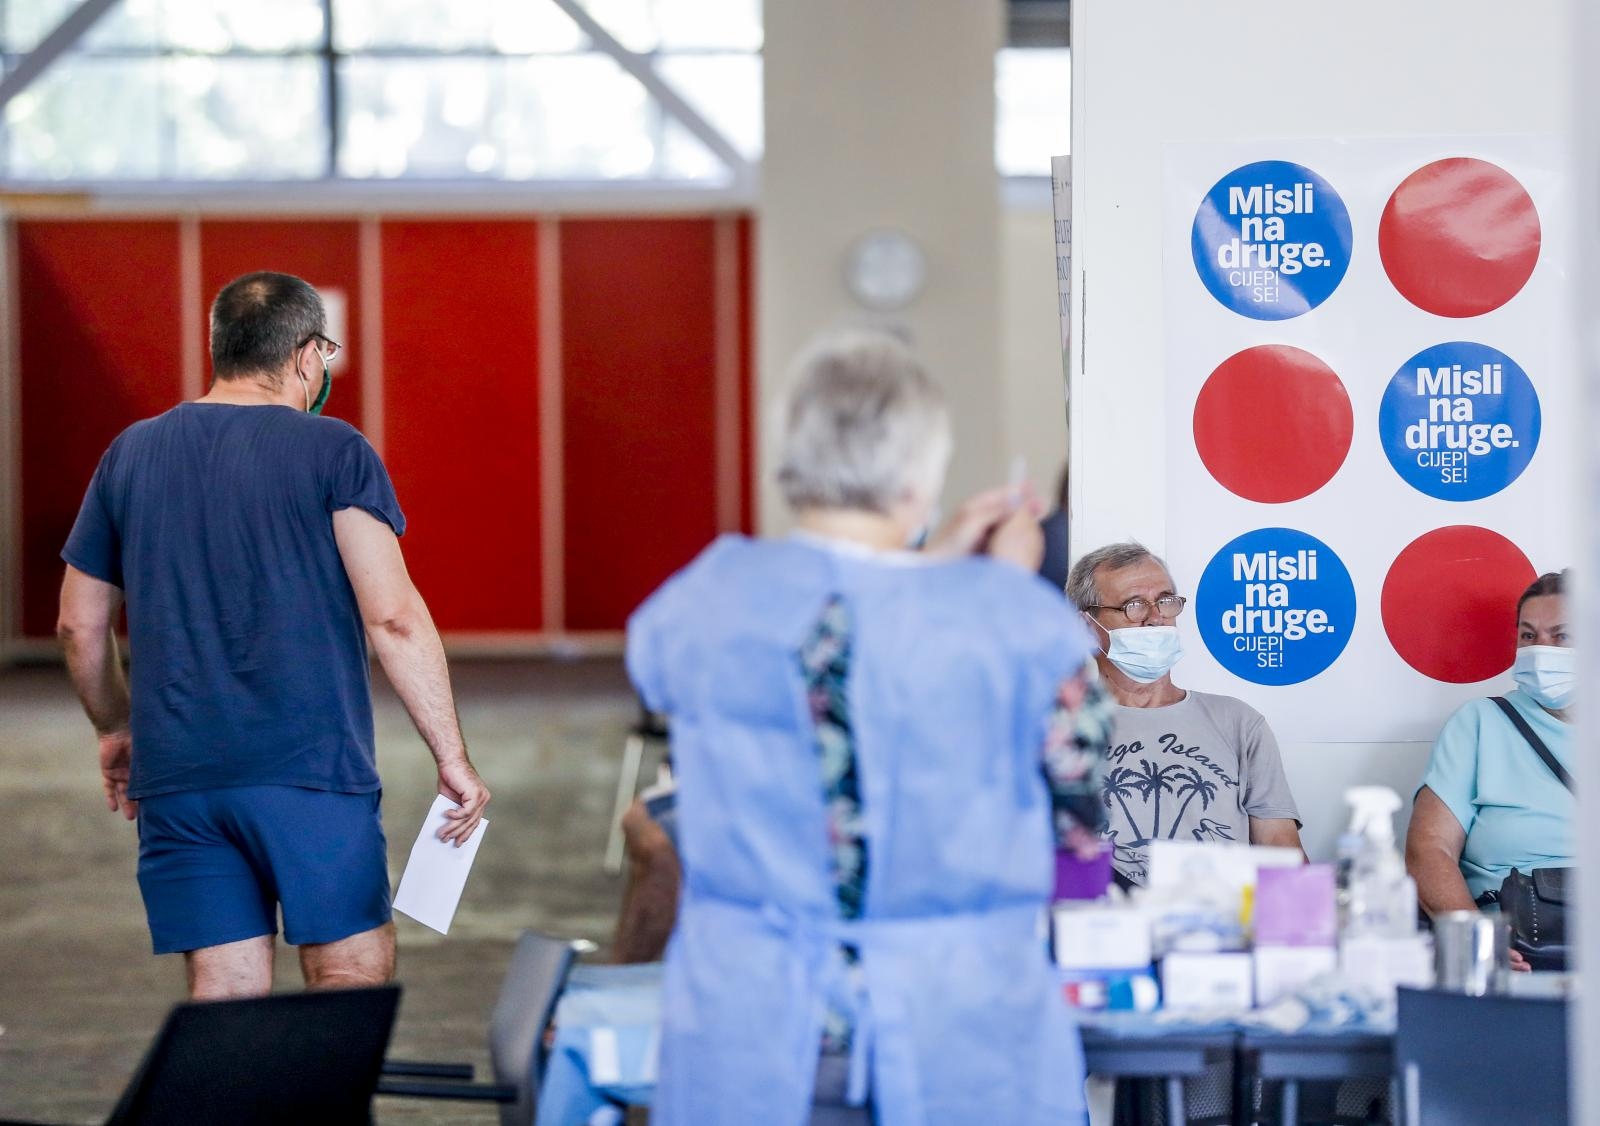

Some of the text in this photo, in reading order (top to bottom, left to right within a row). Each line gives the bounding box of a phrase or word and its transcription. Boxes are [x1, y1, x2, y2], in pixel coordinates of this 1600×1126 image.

[1229, 183, 1313, 214] Misli
[1241, 217, 1285, 242] na
[1218, 238, 1331, 275] druge.
[1229, 271, 1279, 287] CIJEPI
[1253, 287, 1280, 303] SE!
[1416, 364, 1502, 396] Misli
[1430, 397, 1473, 422] na
[1405, 419, 1519, 456] druge.
[1417, 451, 1468, 467] CIJEPI
[1441, 467, 1468, 483] SE!
[1233, 550, 1317, 581] Misli
[1245, 583, 1289, 607] na
[1221, 604, 1335, 641] druge.
[1233, 636, 1283, 652] CIJEPI
[1256, 652, 1284, 668] SE!
[1106, 733, 1239, 789] igo Island
